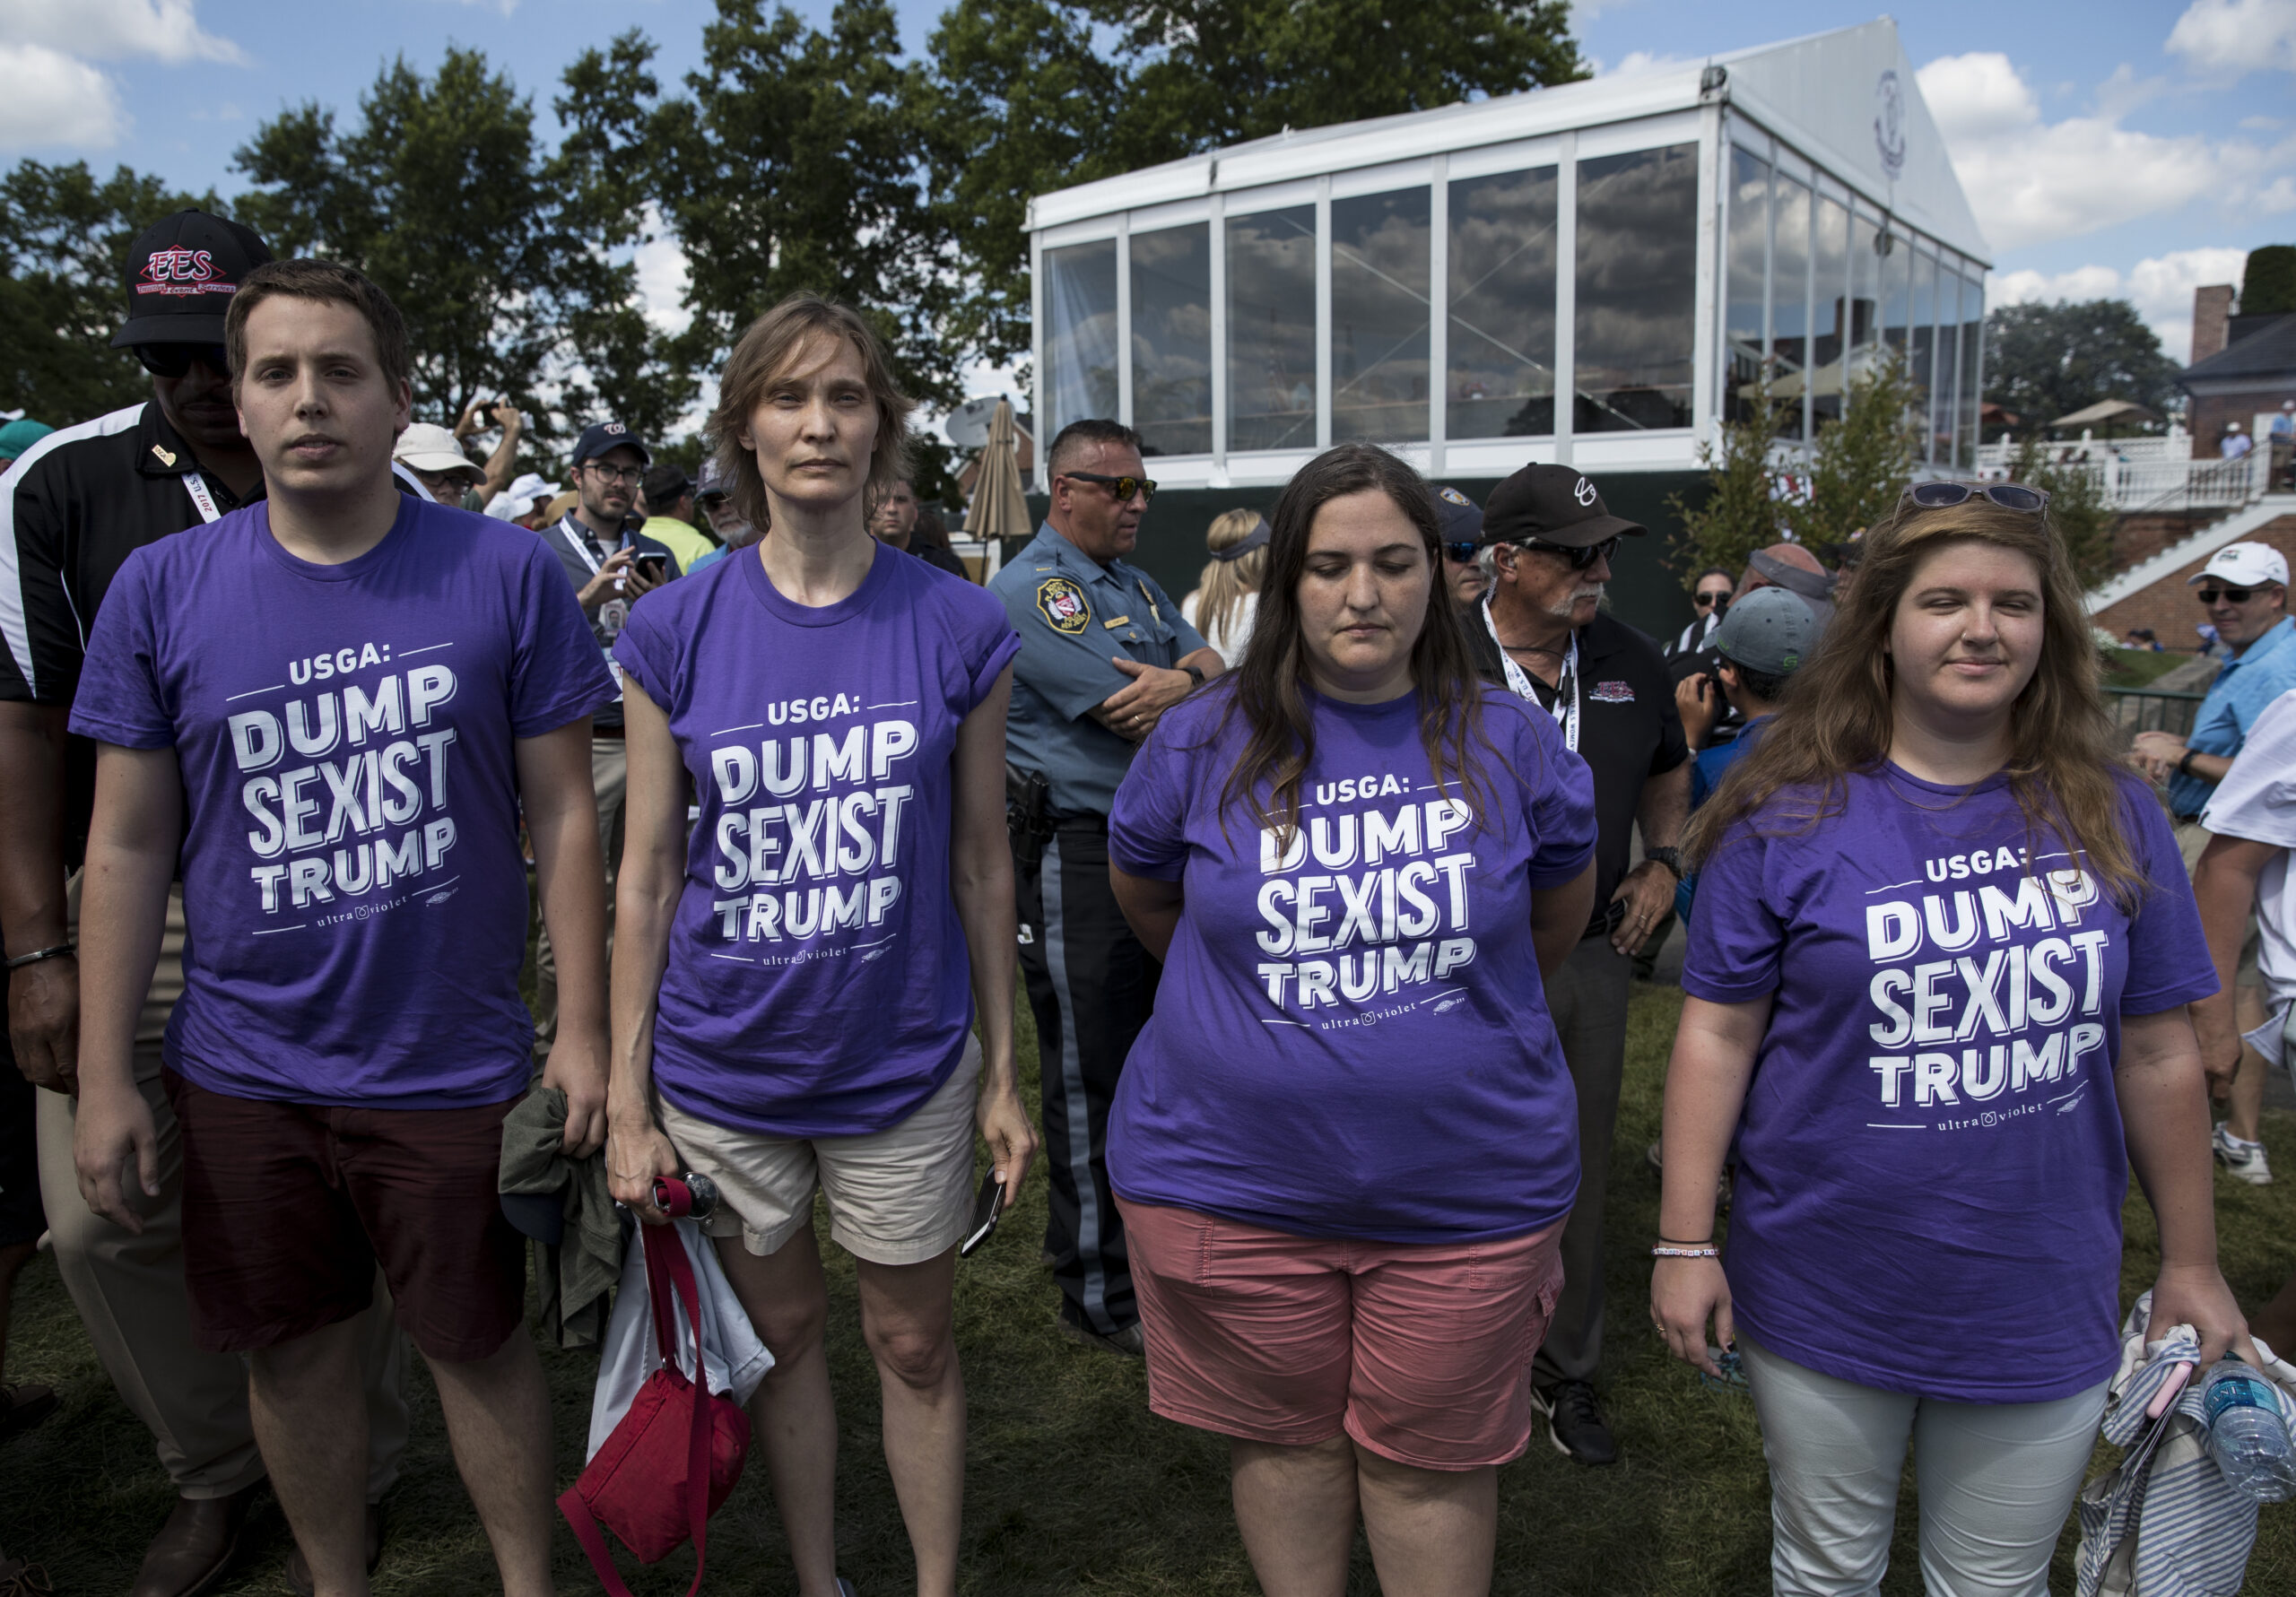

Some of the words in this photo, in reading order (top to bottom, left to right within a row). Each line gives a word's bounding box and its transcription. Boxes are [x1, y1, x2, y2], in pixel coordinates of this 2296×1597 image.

[149, 250, 212, 281] EES
[197, 494, 213, 512] 2017
[289, 642, 390, 685] USGA:
[227, 664, 457, 773] DUMP
[768, 692, 860, 725] USGA:
[242, 727, 457, 858] SEXIST
[711, 719, 918, 806] DUMP
[1317, 774, 1410, 805] USGA:
[251, 817, 457, 914] TRUMP
[715, 785, 914, 891] SEXIST
[1260, 798, 1473, 875] DUMP
[1926, 846, 2028, 882] USGA:
[714, 875, 901, 942] TRUMP
[1256, 853, 1475, 958] SEXIST
[1866, 869, 2099, 964] DUMP
[1257, 937, 1477, 1010] TRUMP
[1869, 930, 2109, 1048] SEXIST
[1869, 1022, 2106, 1107] TRUMP
